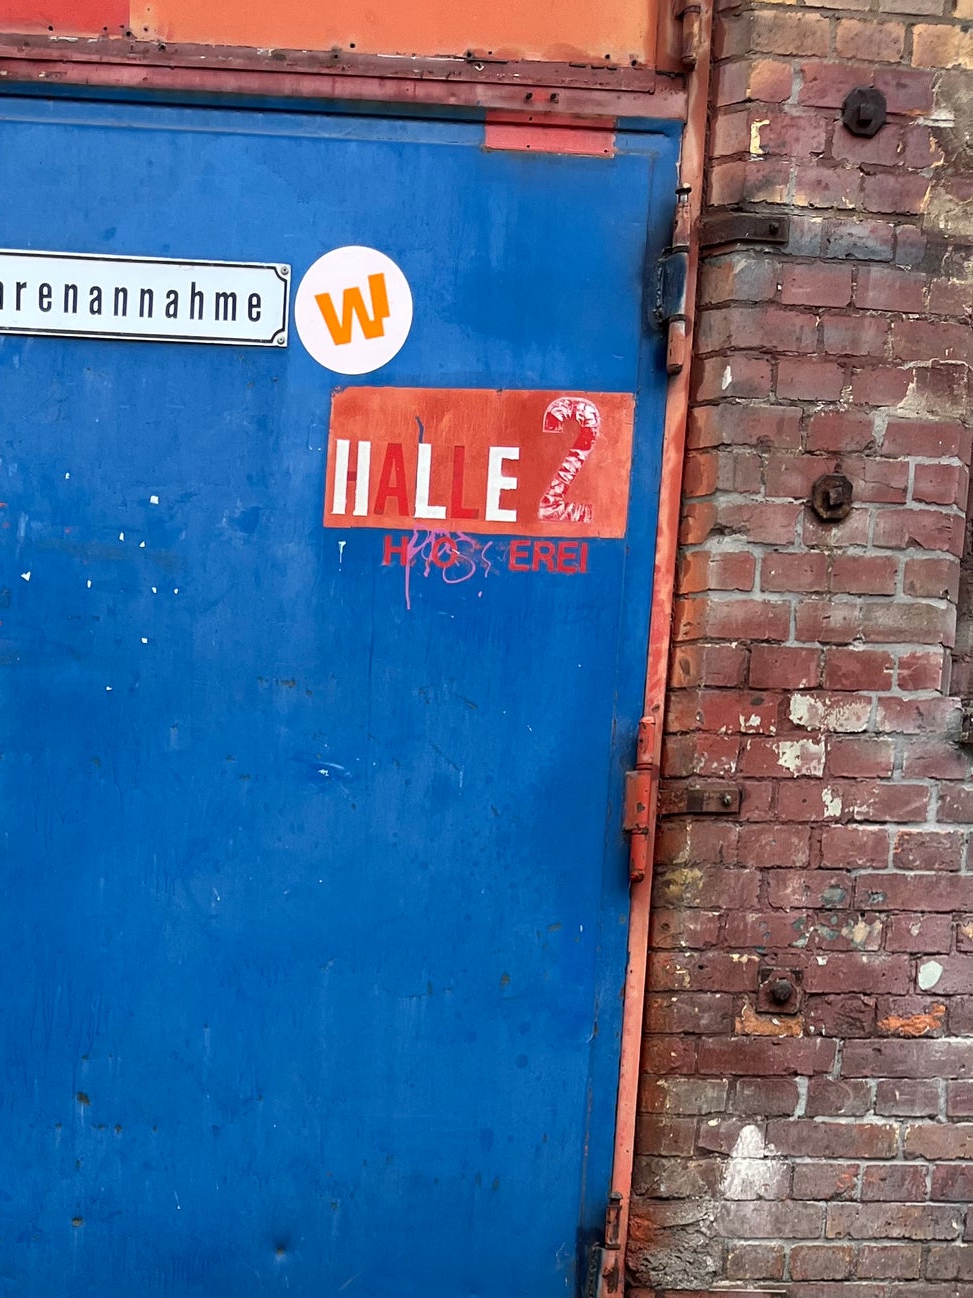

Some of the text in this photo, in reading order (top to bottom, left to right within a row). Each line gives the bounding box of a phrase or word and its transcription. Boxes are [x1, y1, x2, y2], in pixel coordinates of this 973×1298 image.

[315, 272, 391, 346] W
[331, 396, 602, 523] HALLE 2
